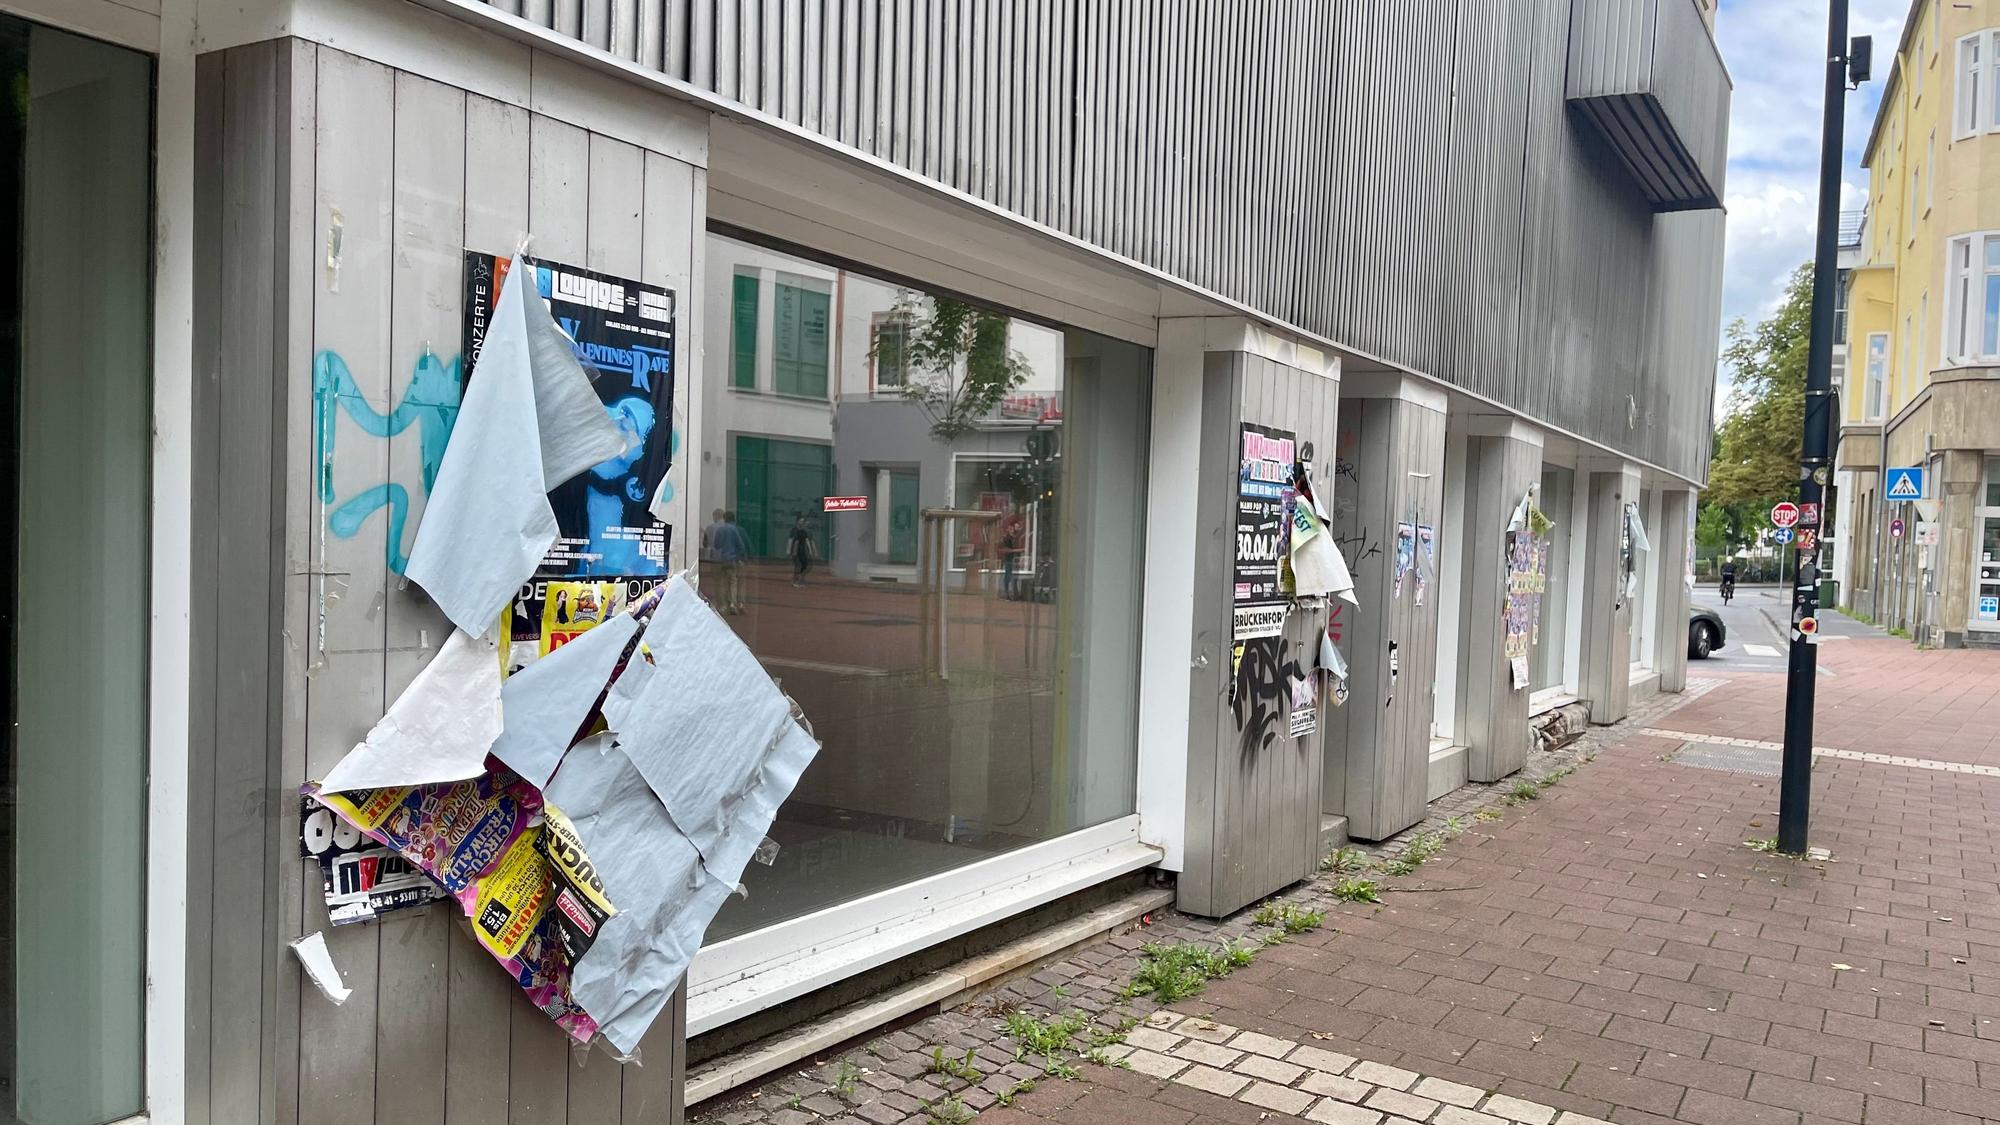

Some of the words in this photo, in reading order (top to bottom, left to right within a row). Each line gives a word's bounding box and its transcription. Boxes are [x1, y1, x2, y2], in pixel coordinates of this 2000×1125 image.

[472, 284, 487, 370] ONZERTE
[631, 351, 670, 392] RAVE
[1774, 509, 1797, 521] STOP
[1237, 533, 1278, 561] 30.04.20
[1235, 611, 1285, 627] BRÜCKENFOR
[448, 808, 505, 880] FREIWALD
[461, 823, 511, 880] CIRCUS
[481, 903, 494, 920] Jun
[484, 909, 501, 925] 15.
[491, 912, 507, 931] Bis
